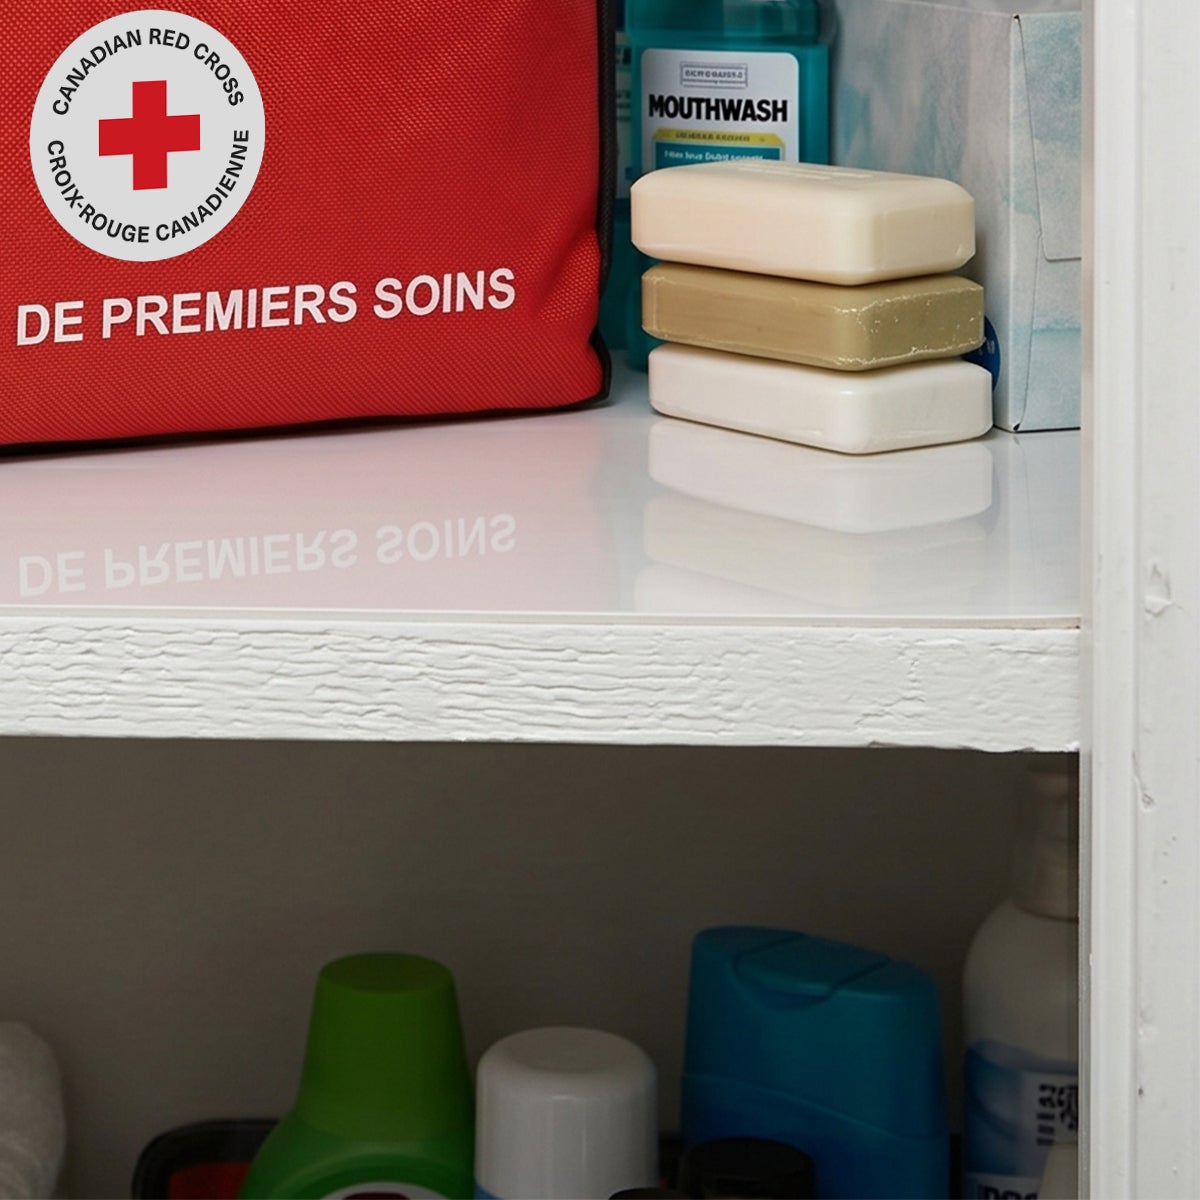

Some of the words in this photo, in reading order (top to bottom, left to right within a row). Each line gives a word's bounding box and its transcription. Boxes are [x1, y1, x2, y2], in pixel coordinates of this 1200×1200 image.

[52, 29, 142, 116] CANADIAN
[149, 28, 190, 50] RED
[193, 43, 244, 106] CROSS
[649, 94, 788, 122] MOUTHWASH
[47, 140, 150, 243] CROIX-ROUGE
[155, 130, 249, 242] CANADIENNE
[16, 300, 84, 346] DE
[102, 281, 357, 339] PREMIERS
[373, 268, 516, 319] SOINS
